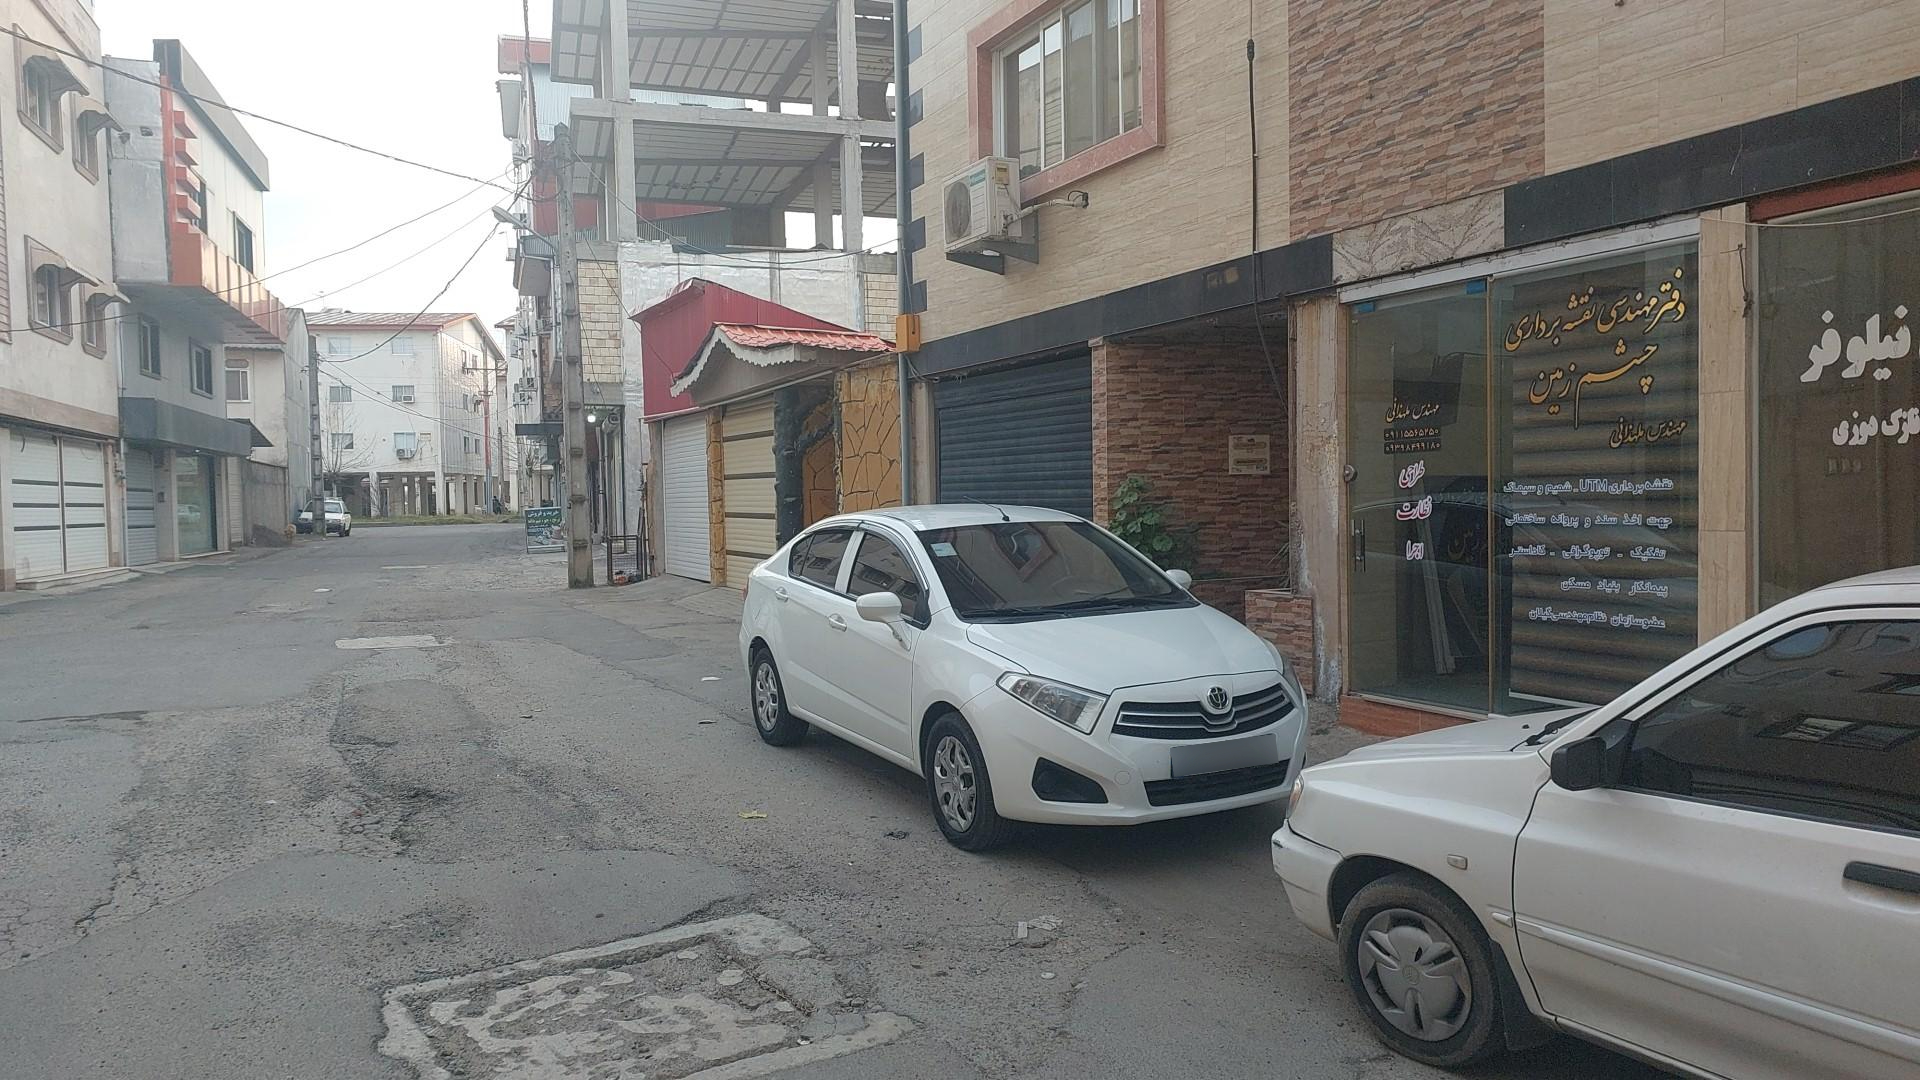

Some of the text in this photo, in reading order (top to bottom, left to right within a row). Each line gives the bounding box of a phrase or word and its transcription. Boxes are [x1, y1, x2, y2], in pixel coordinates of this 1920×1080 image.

[1505, 267, 1686, 351] دفتر مهندسی نقشه برداری
[1800, 304, 1911, 383] نیلوفر
[1529, 338, 1659, 430] چشم زمین
[1412, 403, 1440, 420] مهندس
[1647, 420, 1687, 443] مهندس
[1832, 410, 1878, 446] دوزی
[1399, 460, 1425, 488] طراحی
[1536, 484, 1544, 495] و
[1545, 481, 1572, 495] شمیم
[1579, 478, 1608, 493] UTM
[1608, 482, 1644, 495] برداری
[1644, 478, 1674, 491] نقشه
[1396, 495, 1432, 520] نظارت
[1504, 513, 1673, 529] جهت اخذ سند و پروانه ساختمانی
[1405, 540, 1424, 560] اجرا
[1561, 543, 1611, 561] توپوگرافی
[1629, 546, 1666, 561] تفکیک
[1560, 577, 1668, 598] پیمانکار بنیاد مسکن
